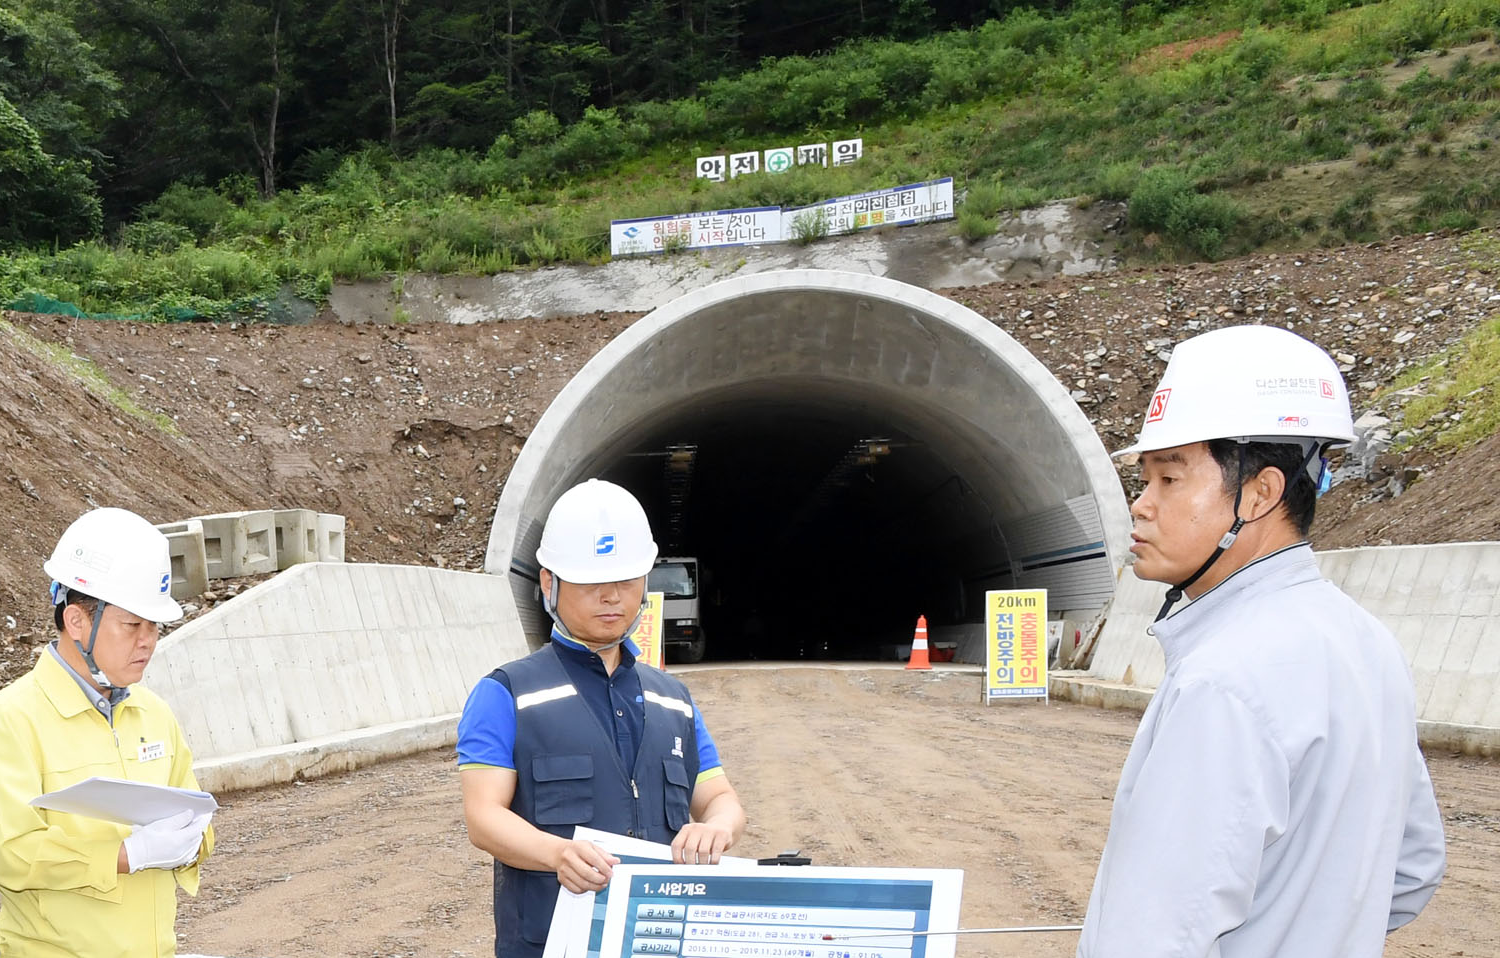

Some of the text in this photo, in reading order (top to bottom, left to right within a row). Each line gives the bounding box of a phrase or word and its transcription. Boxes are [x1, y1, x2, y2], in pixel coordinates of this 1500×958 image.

[855, 190, 915, 213] 안전점검
[900, 201, 947, 218] 지킵니다
[653, 220, 692, 234] 위험을
[699, 217, 725, 230] 보는
[732, 214, 756, 228] 것이
[699, 227, 765, 244] 시작입니다
[998, 596, 1036, 608] 20km
[996, 613, 1014, 684] 전방주의
[1020, 612, 1038, 684] 충돌주의
[643, 882, 706, 896] 1. 사업개요
[700, 928, 714, 937] 427
[641, 943, 672, 953] 공사기간
[688, 944, 730, 954] 2015.11.10
[739, 946, 782, 956] 2019.11.23
[784, 948, 815, 958] (49개월)
